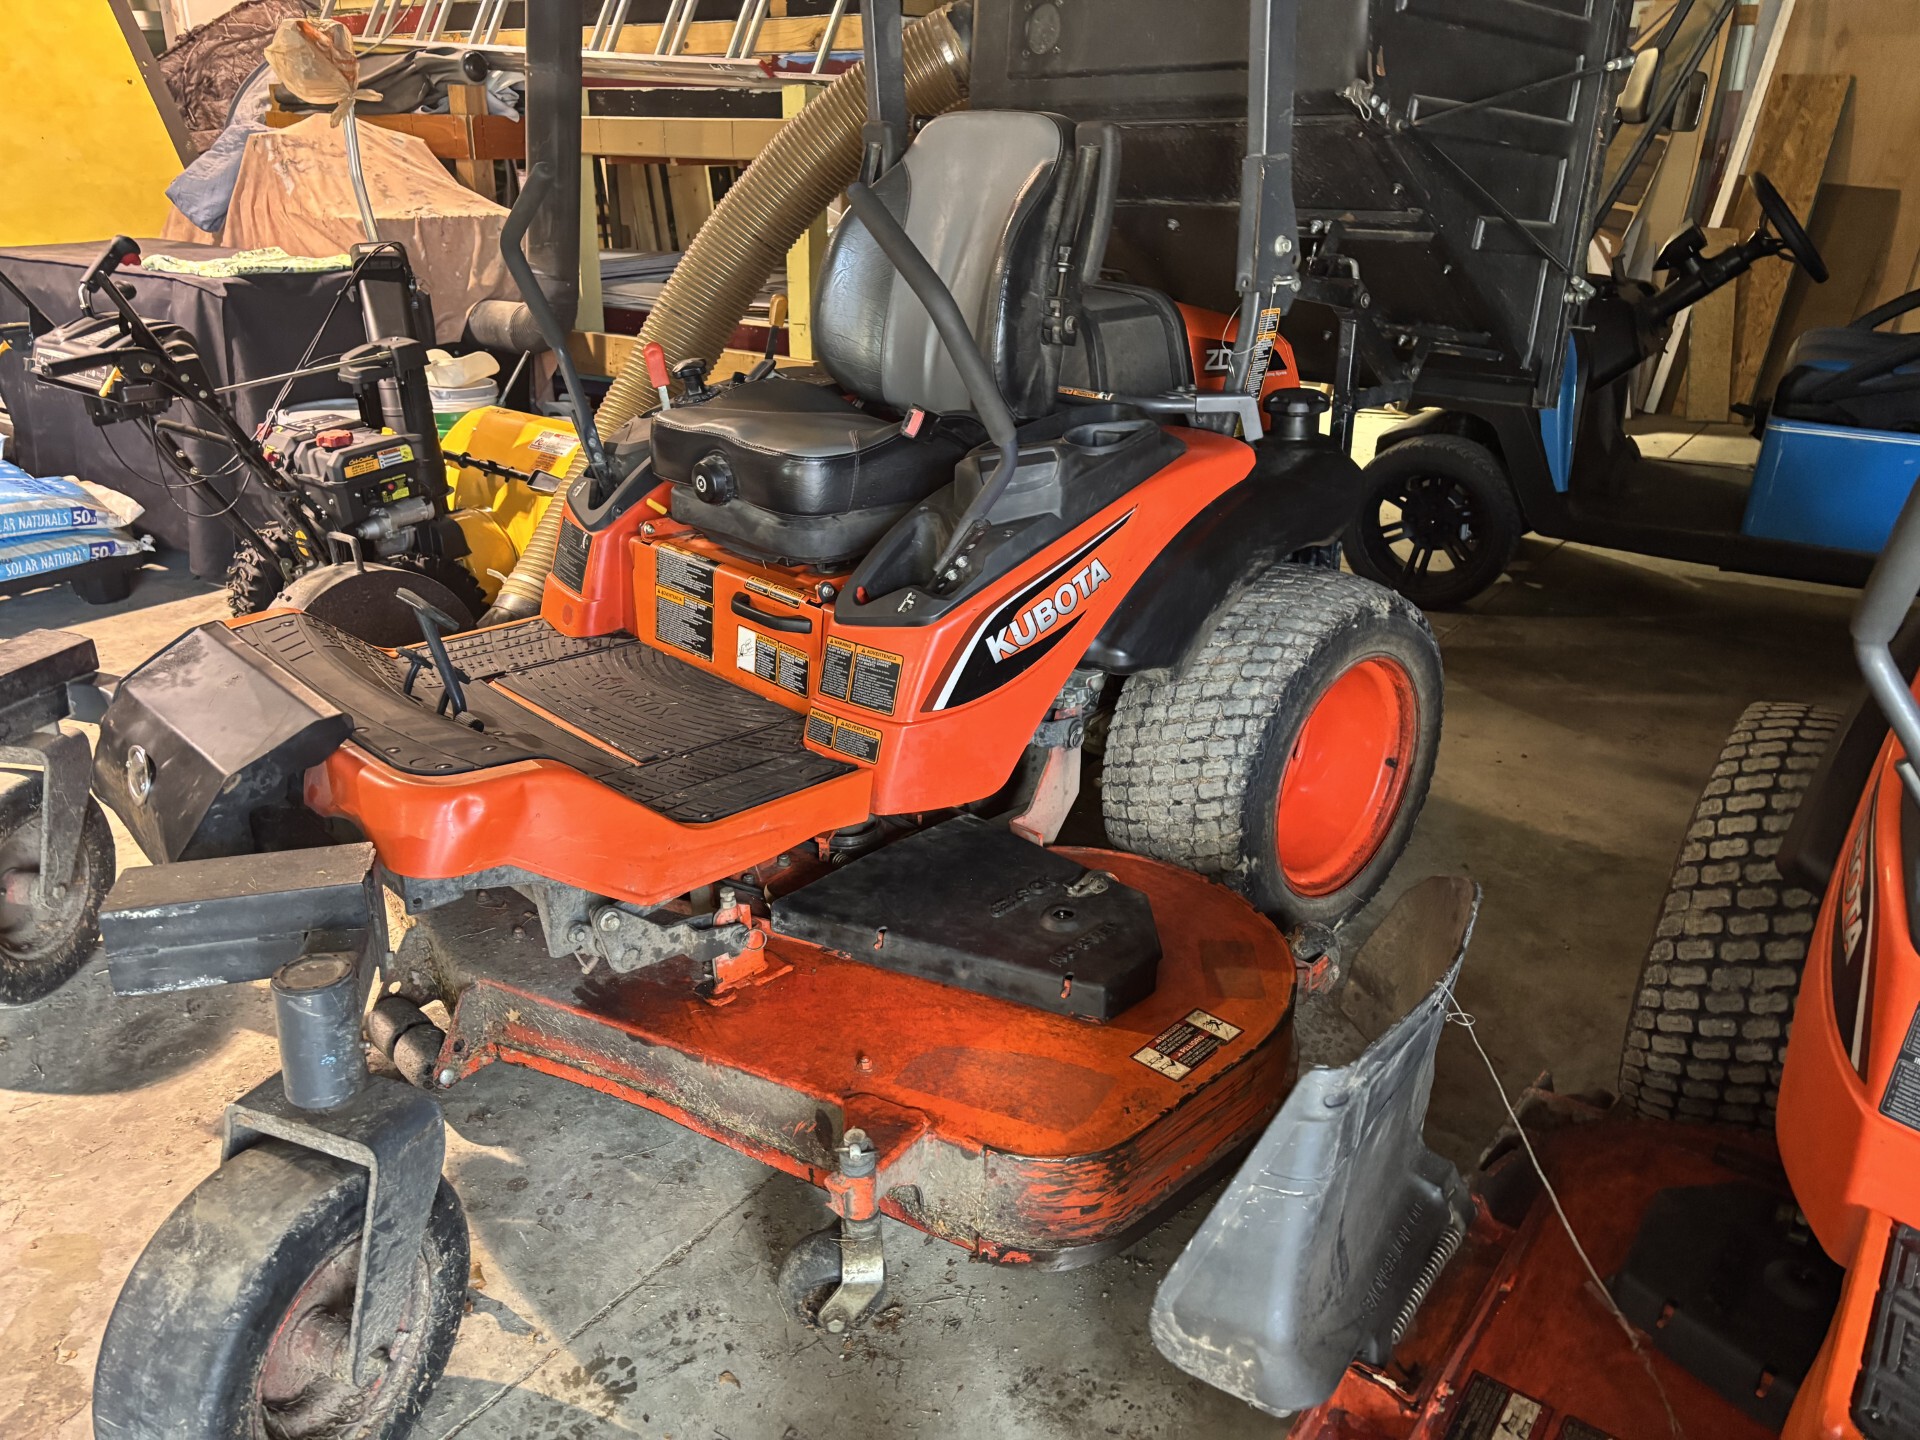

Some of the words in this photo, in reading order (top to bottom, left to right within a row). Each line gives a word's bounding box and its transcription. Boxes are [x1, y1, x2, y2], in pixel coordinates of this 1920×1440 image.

[18, 512, 69, 530] NATURALS
[72, 509, 91, 525] 50
[5, 559, 39, 577] SOLAR
[90, 545, 110, 560] 50
[985, 557, 1112, 664] KUBOTA
[834, 639, 852, 649] WARNING
[866, 649, 897, 661] ADVERTENCIA
[814, 711, 834, 722] WARNING
[845, 722, 877, 737] ADVERTENCIA
[1158, 1022, 1182, 1041] DANGER
[1180, 1034, 1205, 1055] PELIGRO
